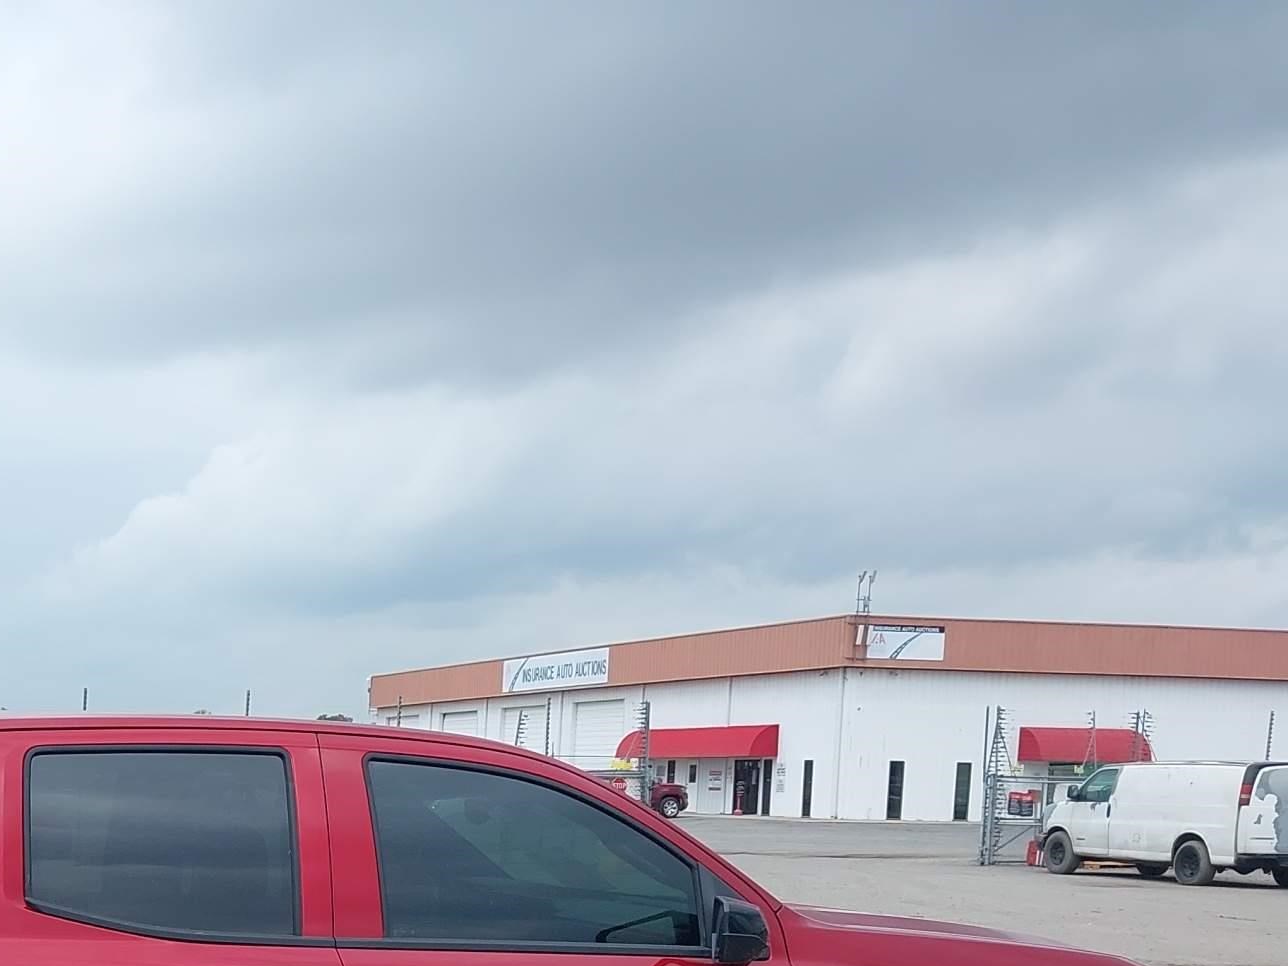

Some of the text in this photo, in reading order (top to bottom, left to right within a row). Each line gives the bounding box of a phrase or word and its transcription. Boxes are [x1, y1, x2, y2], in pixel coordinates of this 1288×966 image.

[522, 659, 607, 683] INSURANCE AUTO AUCTIONS
